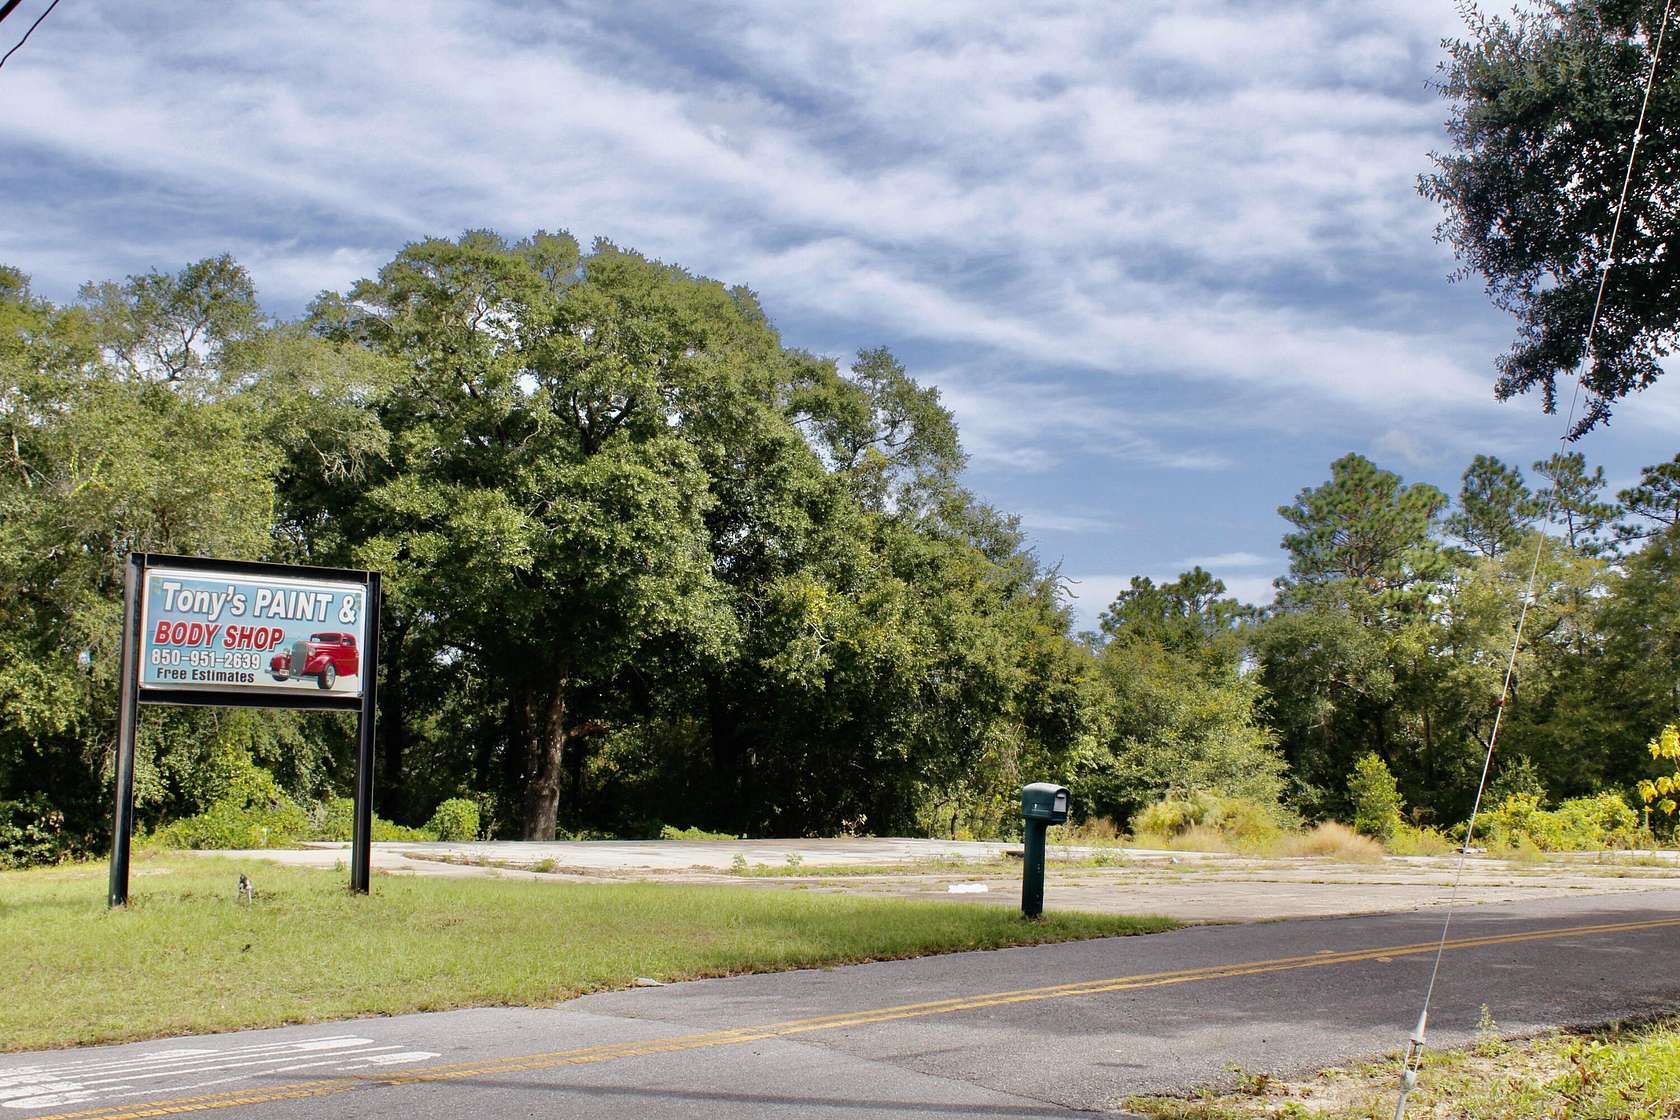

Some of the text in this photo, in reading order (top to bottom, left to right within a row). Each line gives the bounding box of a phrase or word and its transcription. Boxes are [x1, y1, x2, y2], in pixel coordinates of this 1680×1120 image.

[162, 581, 356, 624] Tony's PAINT &
[153, 620, 285, 651] BODY SHOP
[151, 648, 261, 670] 850-951-2639
[157, 667, 255, 683] Free Estimates
